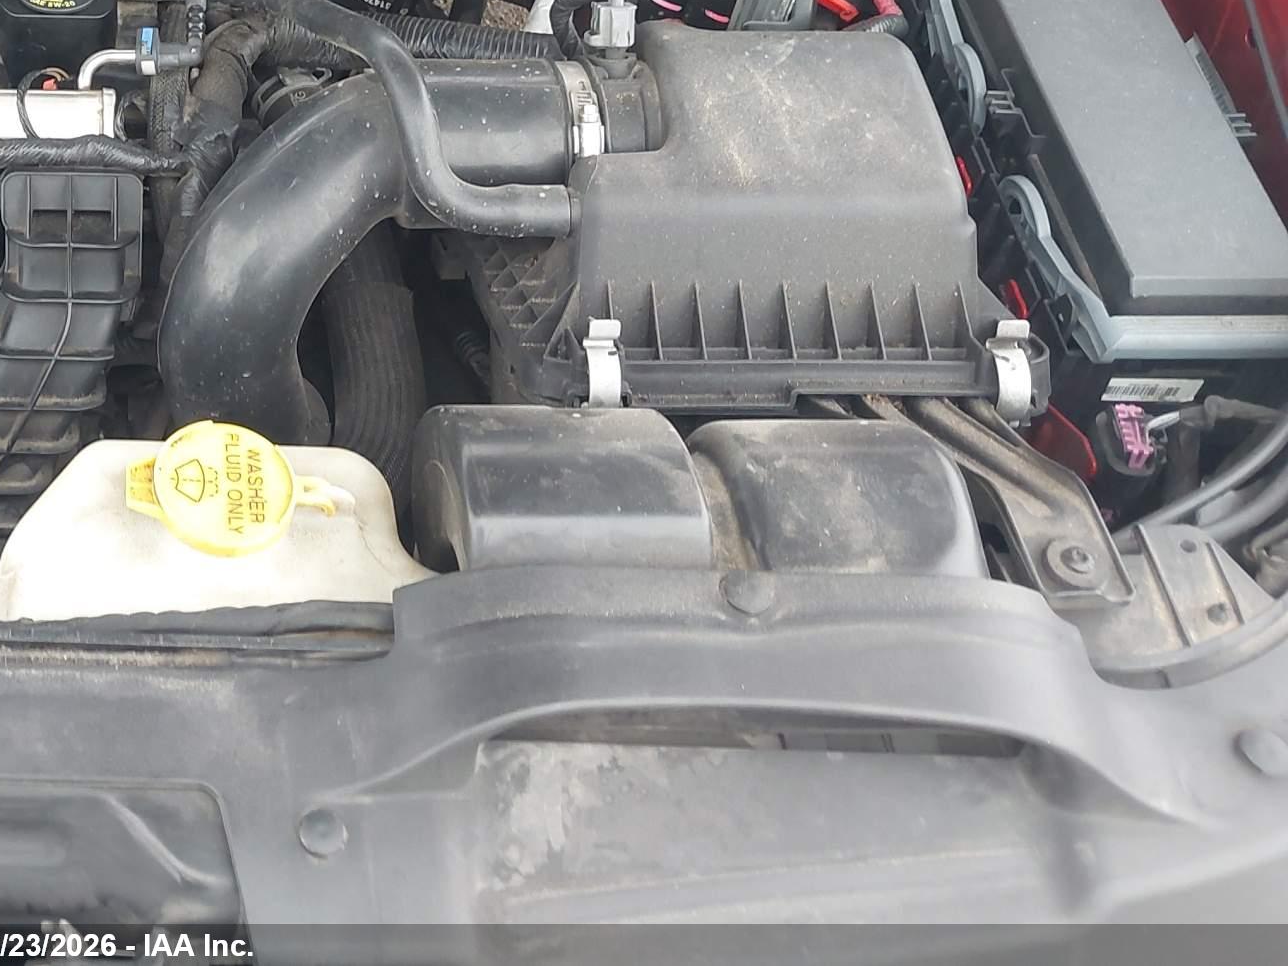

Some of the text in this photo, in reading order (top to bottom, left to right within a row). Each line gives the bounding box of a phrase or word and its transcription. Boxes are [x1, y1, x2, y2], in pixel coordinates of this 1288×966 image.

[225, 433, 244, 535] FLUID ONLY
[247, 449, 265, 523] WASHER
